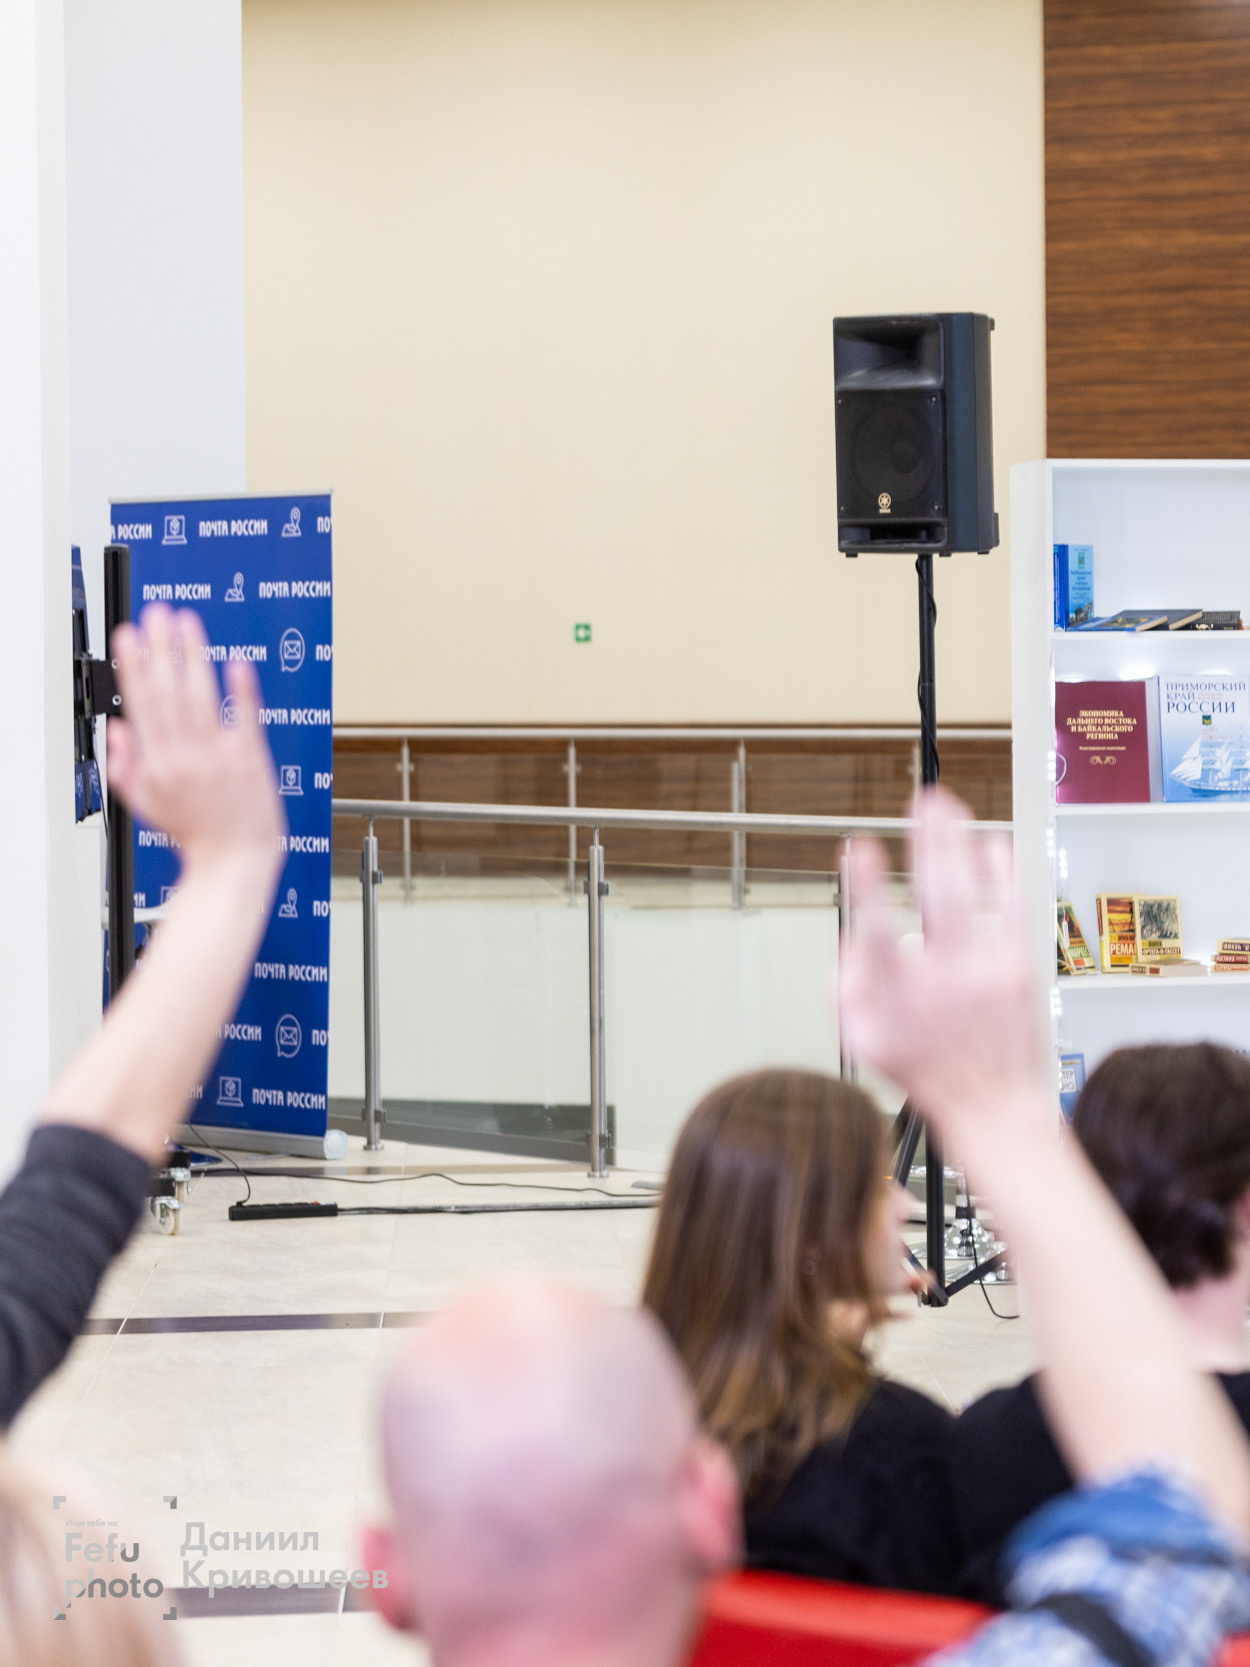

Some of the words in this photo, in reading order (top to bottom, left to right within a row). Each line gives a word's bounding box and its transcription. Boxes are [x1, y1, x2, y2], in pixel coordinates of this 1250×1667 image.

[118, 523, 152, 539] РОССИИ
[199, 520, 228, 537] ПОЧТА
[230, 519, 268, 536] РОССИИ
[317, 516, 332, 533] ПО
[143, 584, 173, 601] ПОЧТА
[174, 583, 211, 600] РОССИИ
[259, 581, 288, 598] ПОЧТА
[289, 580, 331, 598] РОССИИ
[200, 645, 228, 661] ПОЧТА
[229, 645, 267, 661] РОССИИ
[316, 644, 333, 661] ПО
[1166, 681, 1246, 691] ПРИМОРСКИЙ
[1166, 692, 1195, 700] КРАЙ
[1167, 701, 1235, 713] РОССИИ
[258, 708, 288, 725] ПОЧТА
[290, 708, 331, 725] РОССИИ
[1066, 717, 1103, 726] ДАЛЬНЕГО
[1104, 717, 1137, 725] ВОСТОКА
[1078, 724, 1133, 732] БАЙКАЛЬСКОГО
[314, 772, 333, 789] ПО
[138, 830, 169, 847] ПОЧТА
[289, 836, 330, 853] РОССИИ
[313, 900, 331, 918] ПО
[1110, 943, 1136, 956] РЕМА
[254, 962, 286, 980] ПОЧТА
[288, 963, 328, 982] РОССИИ
[224, 1023, 262, 1041] РОССИИ
[312, 1029, 330, 1047] ПО
[252, 1088, 285, 1106] ПОЧТА
[286, 1091, 326, 1110] РОССИИ
